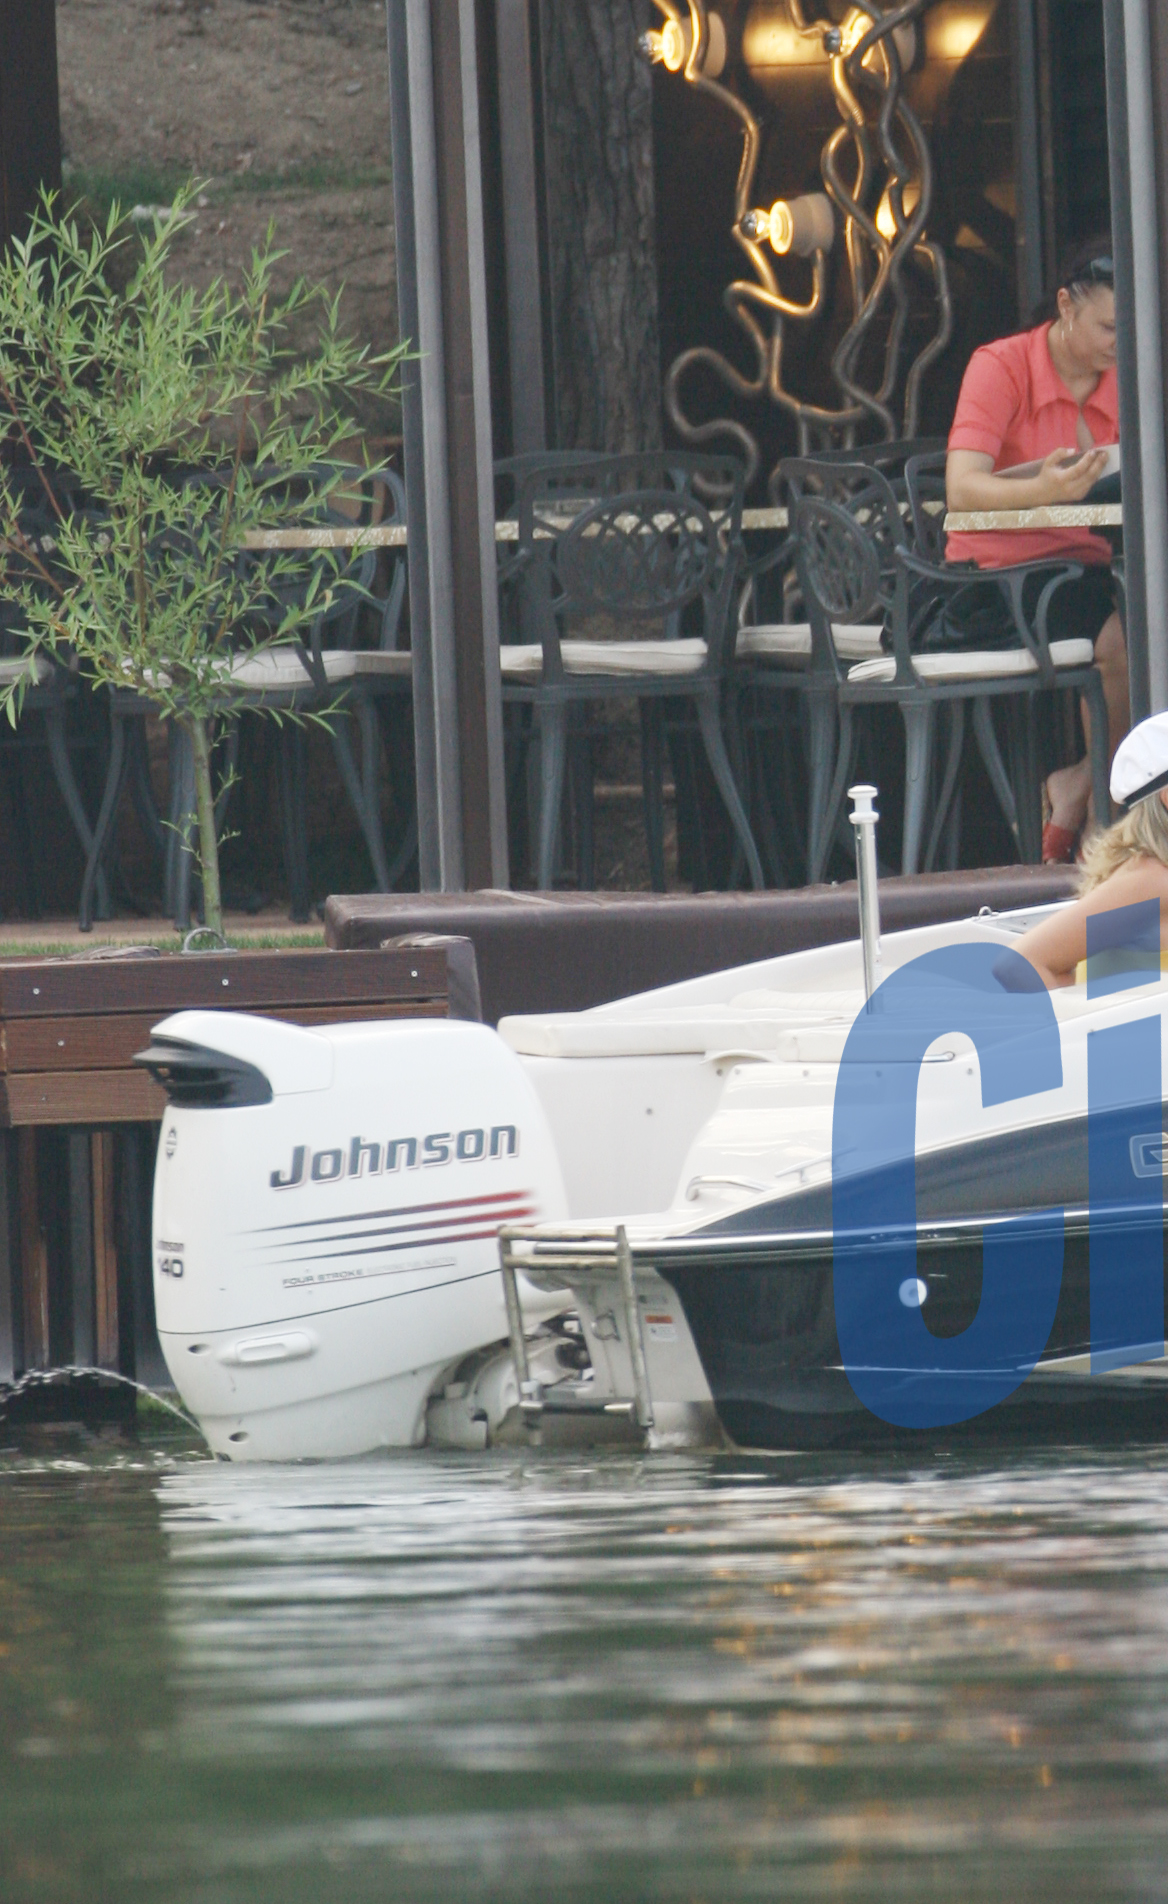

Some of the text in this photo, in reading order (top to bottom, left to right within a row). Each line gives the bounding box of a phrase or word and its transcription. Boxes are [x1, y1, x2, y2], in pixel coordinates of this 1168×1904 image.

[269, 1124, 519, 1190] Johnson
[282, 1268, 364, 1286] FOUR STROKE
